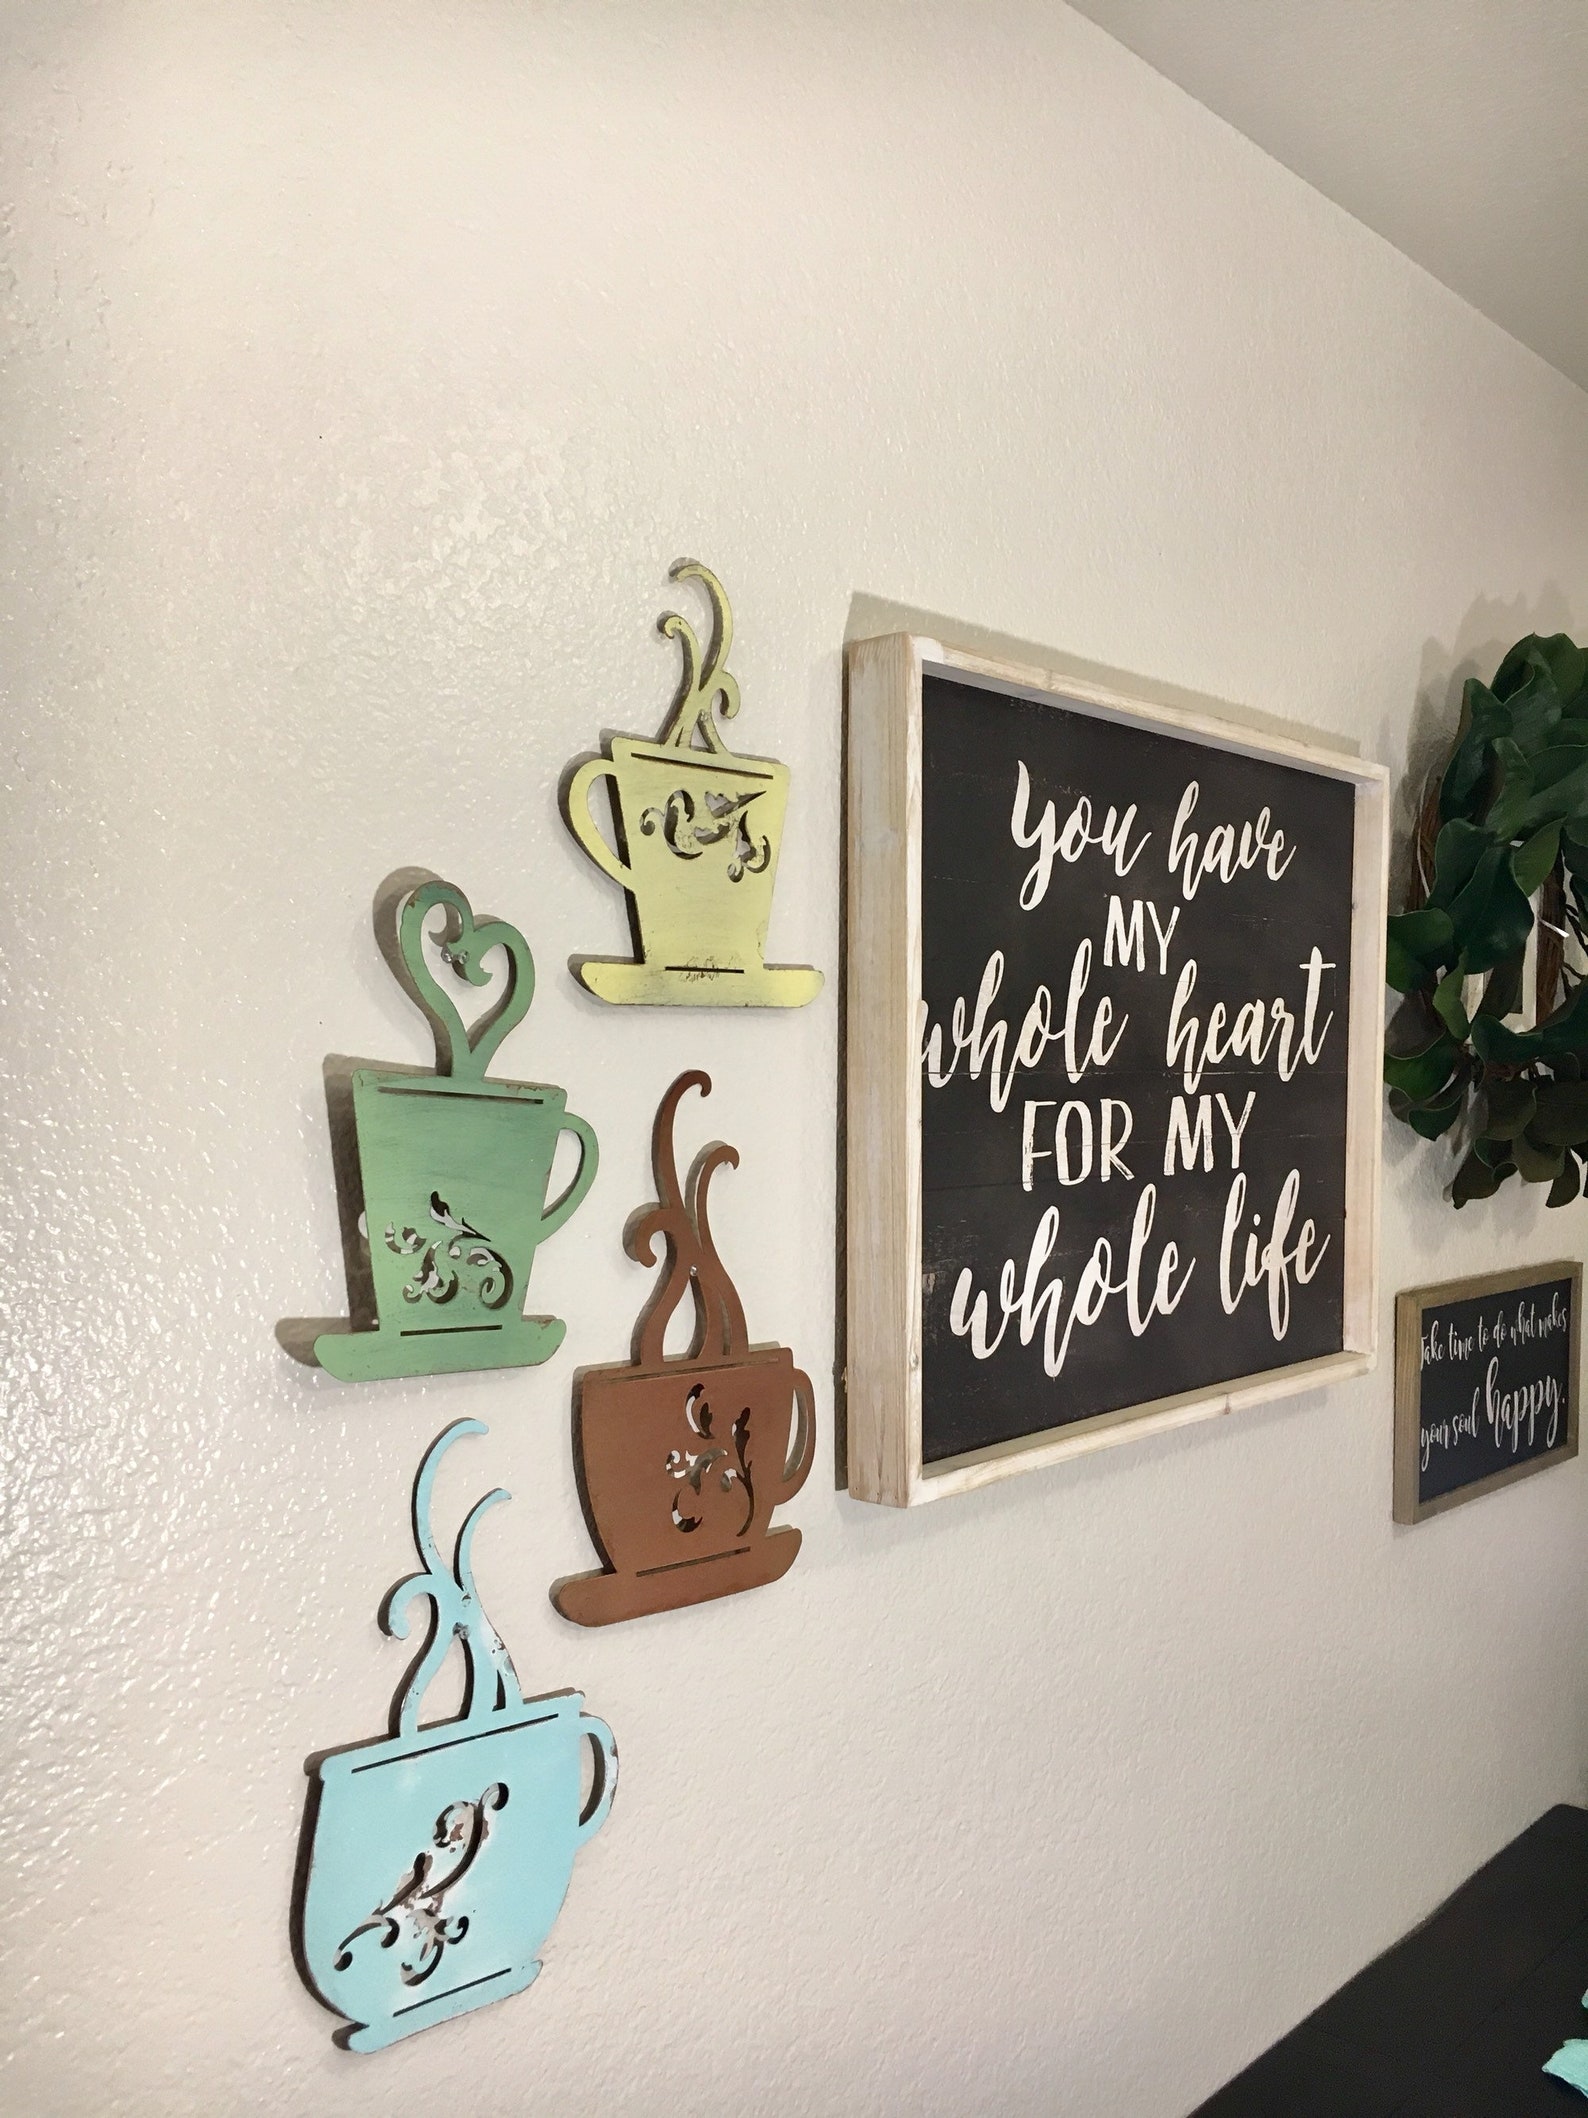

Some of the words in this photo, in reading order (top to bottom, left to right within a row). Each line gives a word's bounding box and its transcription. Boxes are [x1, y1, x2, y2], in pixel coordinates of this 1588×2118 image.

[1169, 780, 1296, 900] have
[1104, 896, 1180, 974] MY
[922, 938, 1128, 1113] whole
[1166, 946, 1336, 1094] heart
[1021, 1099, 1134, 1191] FOR
[1164, 1091, 1255, 1176] MY
[950, 1183, 1196, 1378] whole
[1220, 1168, 1331, 1341] life
[1449, 1323, 1474, 1361] time
[1477, 1315, 1489, 1352] to
[1493, 1310, 1507, 1349] do
[1510, 1301, 1535, 1346] what
[1539, 1292, 1567, 1338] makes
[1421, 1419, 1450, 1472] your
[1452, 1387, 1480, 1446] soul
[1485, 1356, 1566, 1453] happy.
